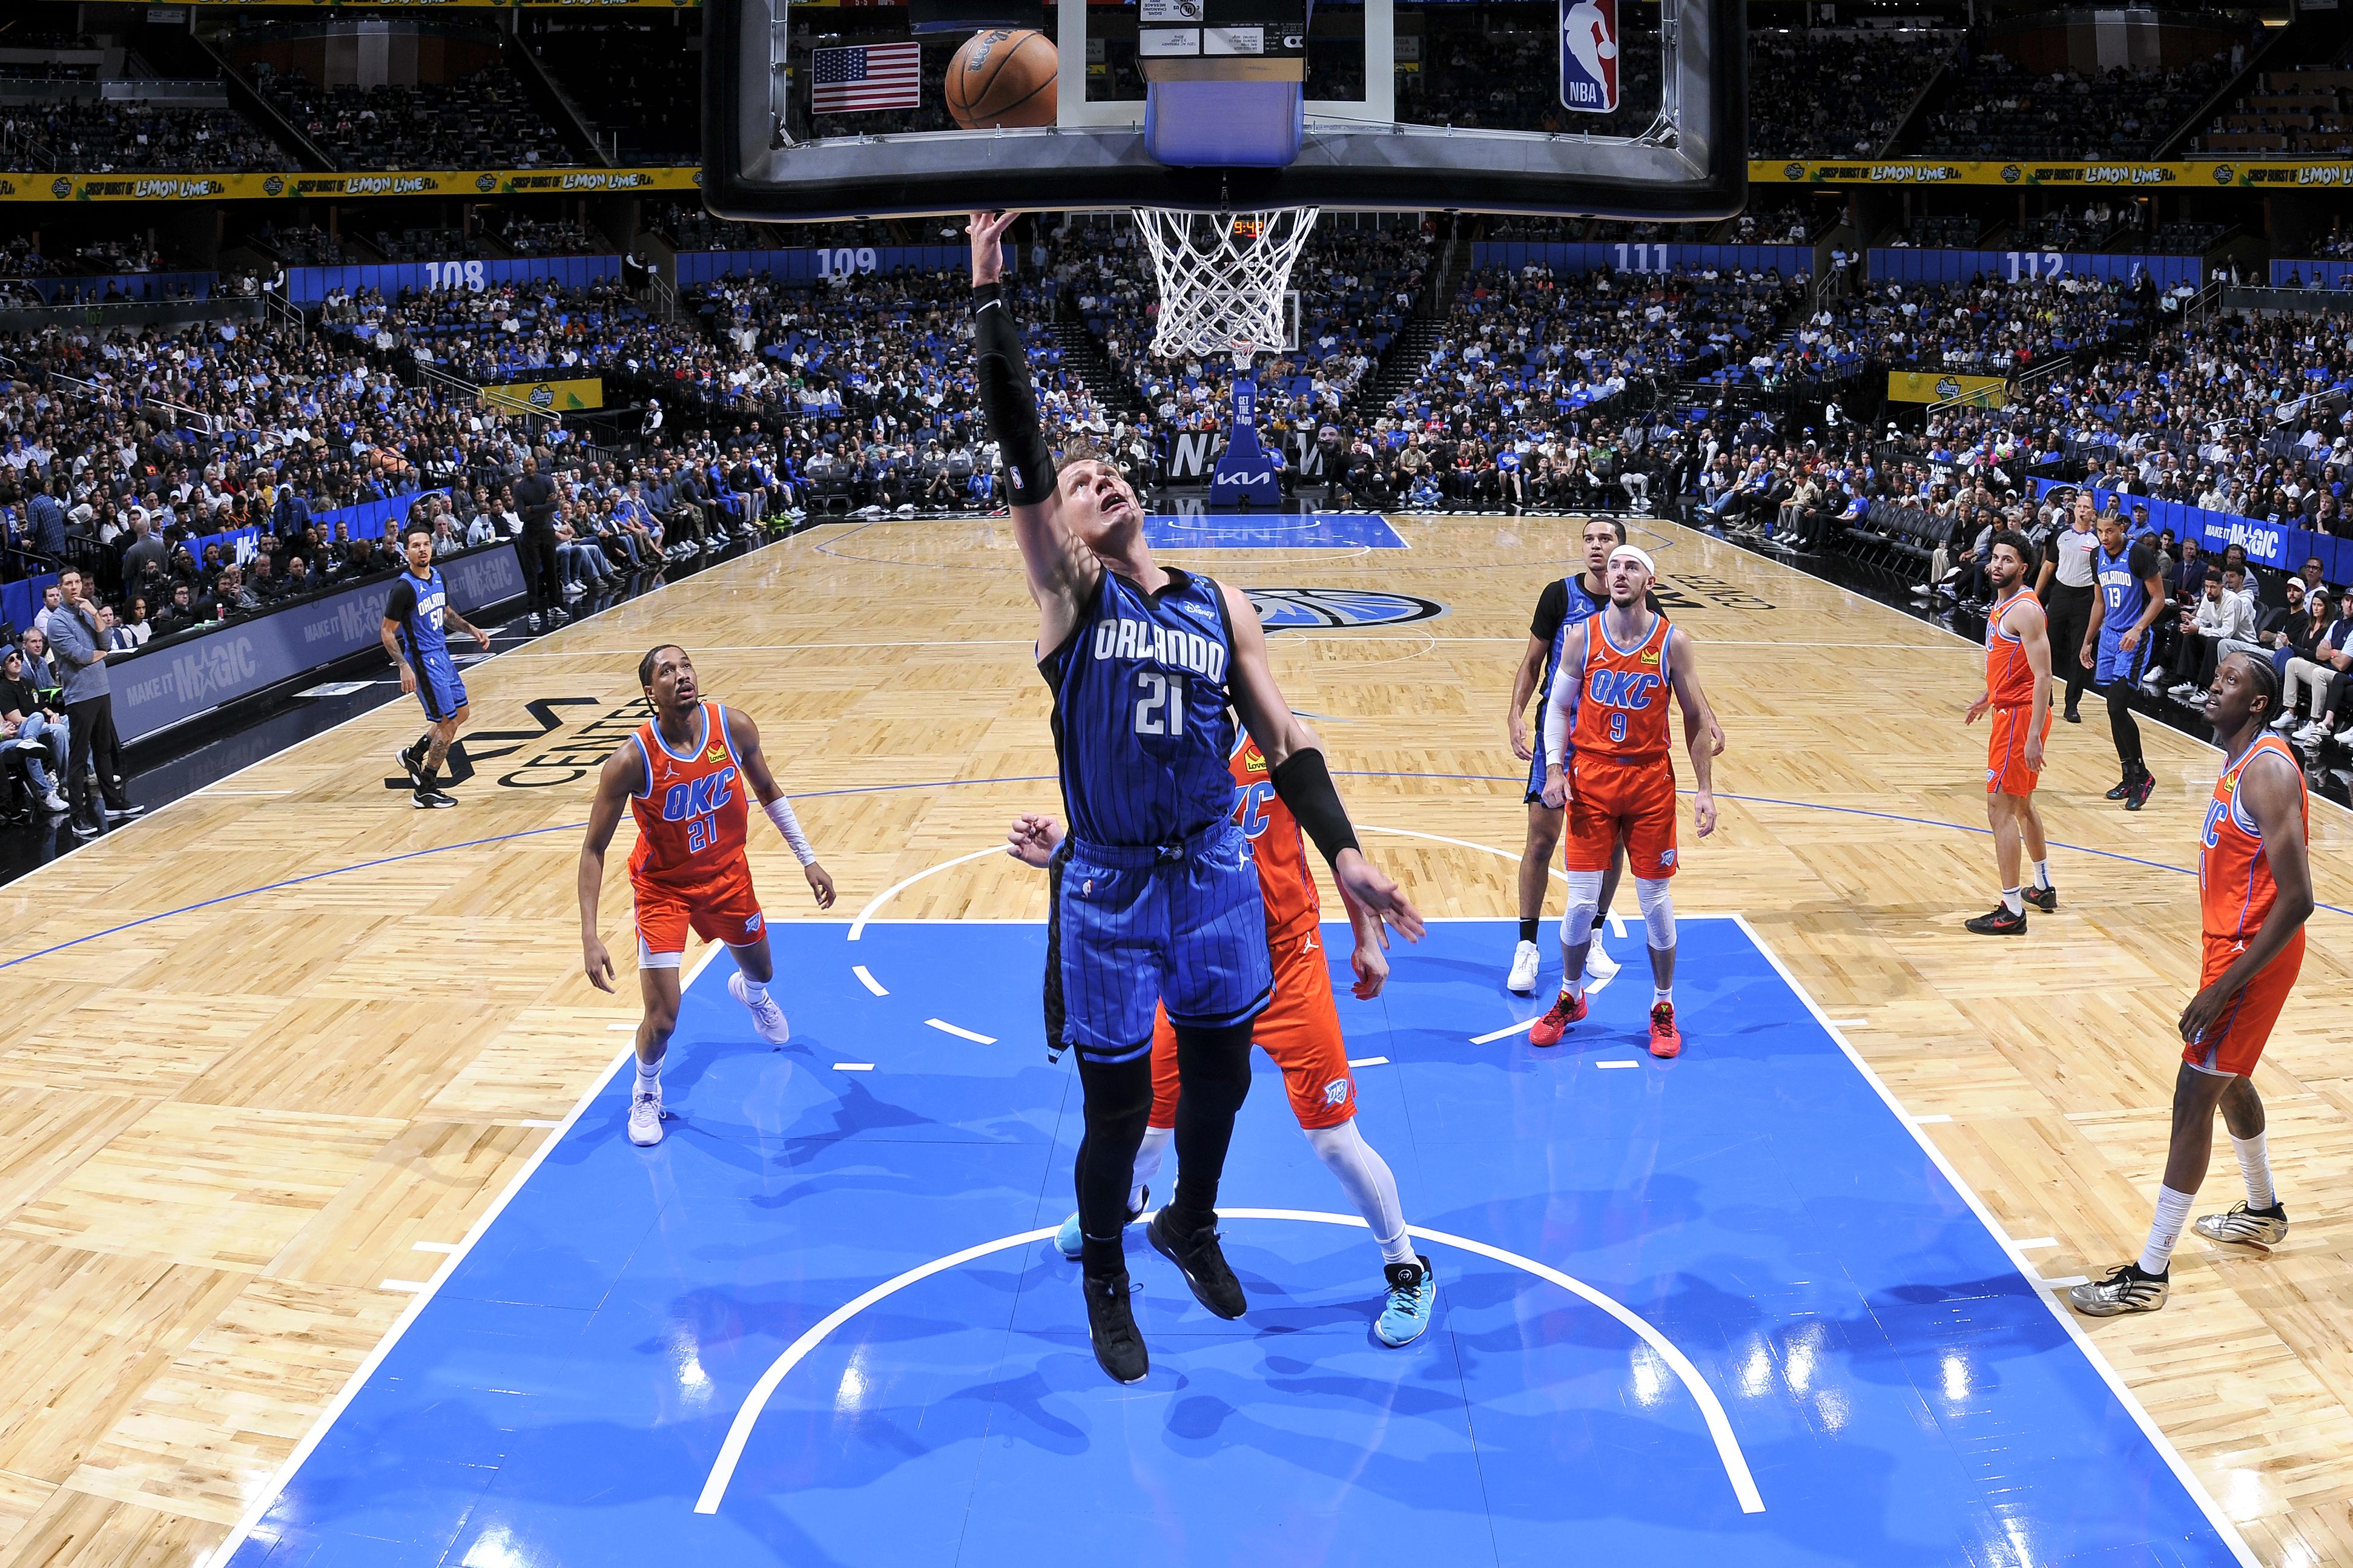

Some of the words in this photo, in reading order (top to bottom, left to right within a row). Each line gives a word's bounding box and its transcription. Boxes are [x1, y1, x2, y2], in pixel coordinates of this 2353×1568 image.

[1569, 81, 1597, 104] NBA
[562, 173, 607, 189] LEMON
[608, 171, 638, 189] LIME
[1870, 165, 1915, 181] LEMON
[1916, 163, 1947, 181] LIME
[2084, 166, 2130, 184] LEMON
[2131, 165, 2162, 183] LIME
[2299, 166, 2340, 185] LEMON
[135, 179, 177, 198] LEMON
[179, 179, 210, 198] LIME
[346, 176, 391, 194] LEMON
[394, 176, 423, 194] LIME
[817, 248, 877, 278] 109
[1614, 243, 1672, 275] 111
[2007, 252, 2064, 285] 112
[425, 260, 485, 294] 108
[84, 309, 104, 325] 107
[530, 388, 554, 404] Starry
[1936, 380, 1961, 398] Starry
[1238, 396, 1249, 406] GET
[1238, 406, 1250, 414] THE
[1217, 472, 1270, 485] KIA
[1524, 511, 1656, 519] MAGIC
[2205, 524, 2223, 539] MAKE
[2223, 529, 2231, 540] IT
[2229, 523, 2279, 559] MAGIC
[464, 555, 513, 599] MAGIC
[2097, 570, 2132, 587] ORLANDO
[1666, 574, 1777, 610] CENTER
[2108, 587, 2121, 608] 13
[430, 608, 443, 630] 50
[1183, 601, 1215, 620] Disney
[304, 622, 332, 643] MAKE
[331, 616, 340, 633] IT
[1094, 619, 1225, 684] ORLANDO
[126, 677, 162, 707] MAKE
[162, 673, 173, 694] IT
[172, 636, 256, 703] MAGIC
[1590, 668, 1661, 710] OKC
[1135, 672, 1183, 736] 21
[1609, 712, 1627, 743] 9
[384, 697, 600, 789] KIA
[662, 766, 736, 822] OKC
[687, 813, 718, 854] 21
